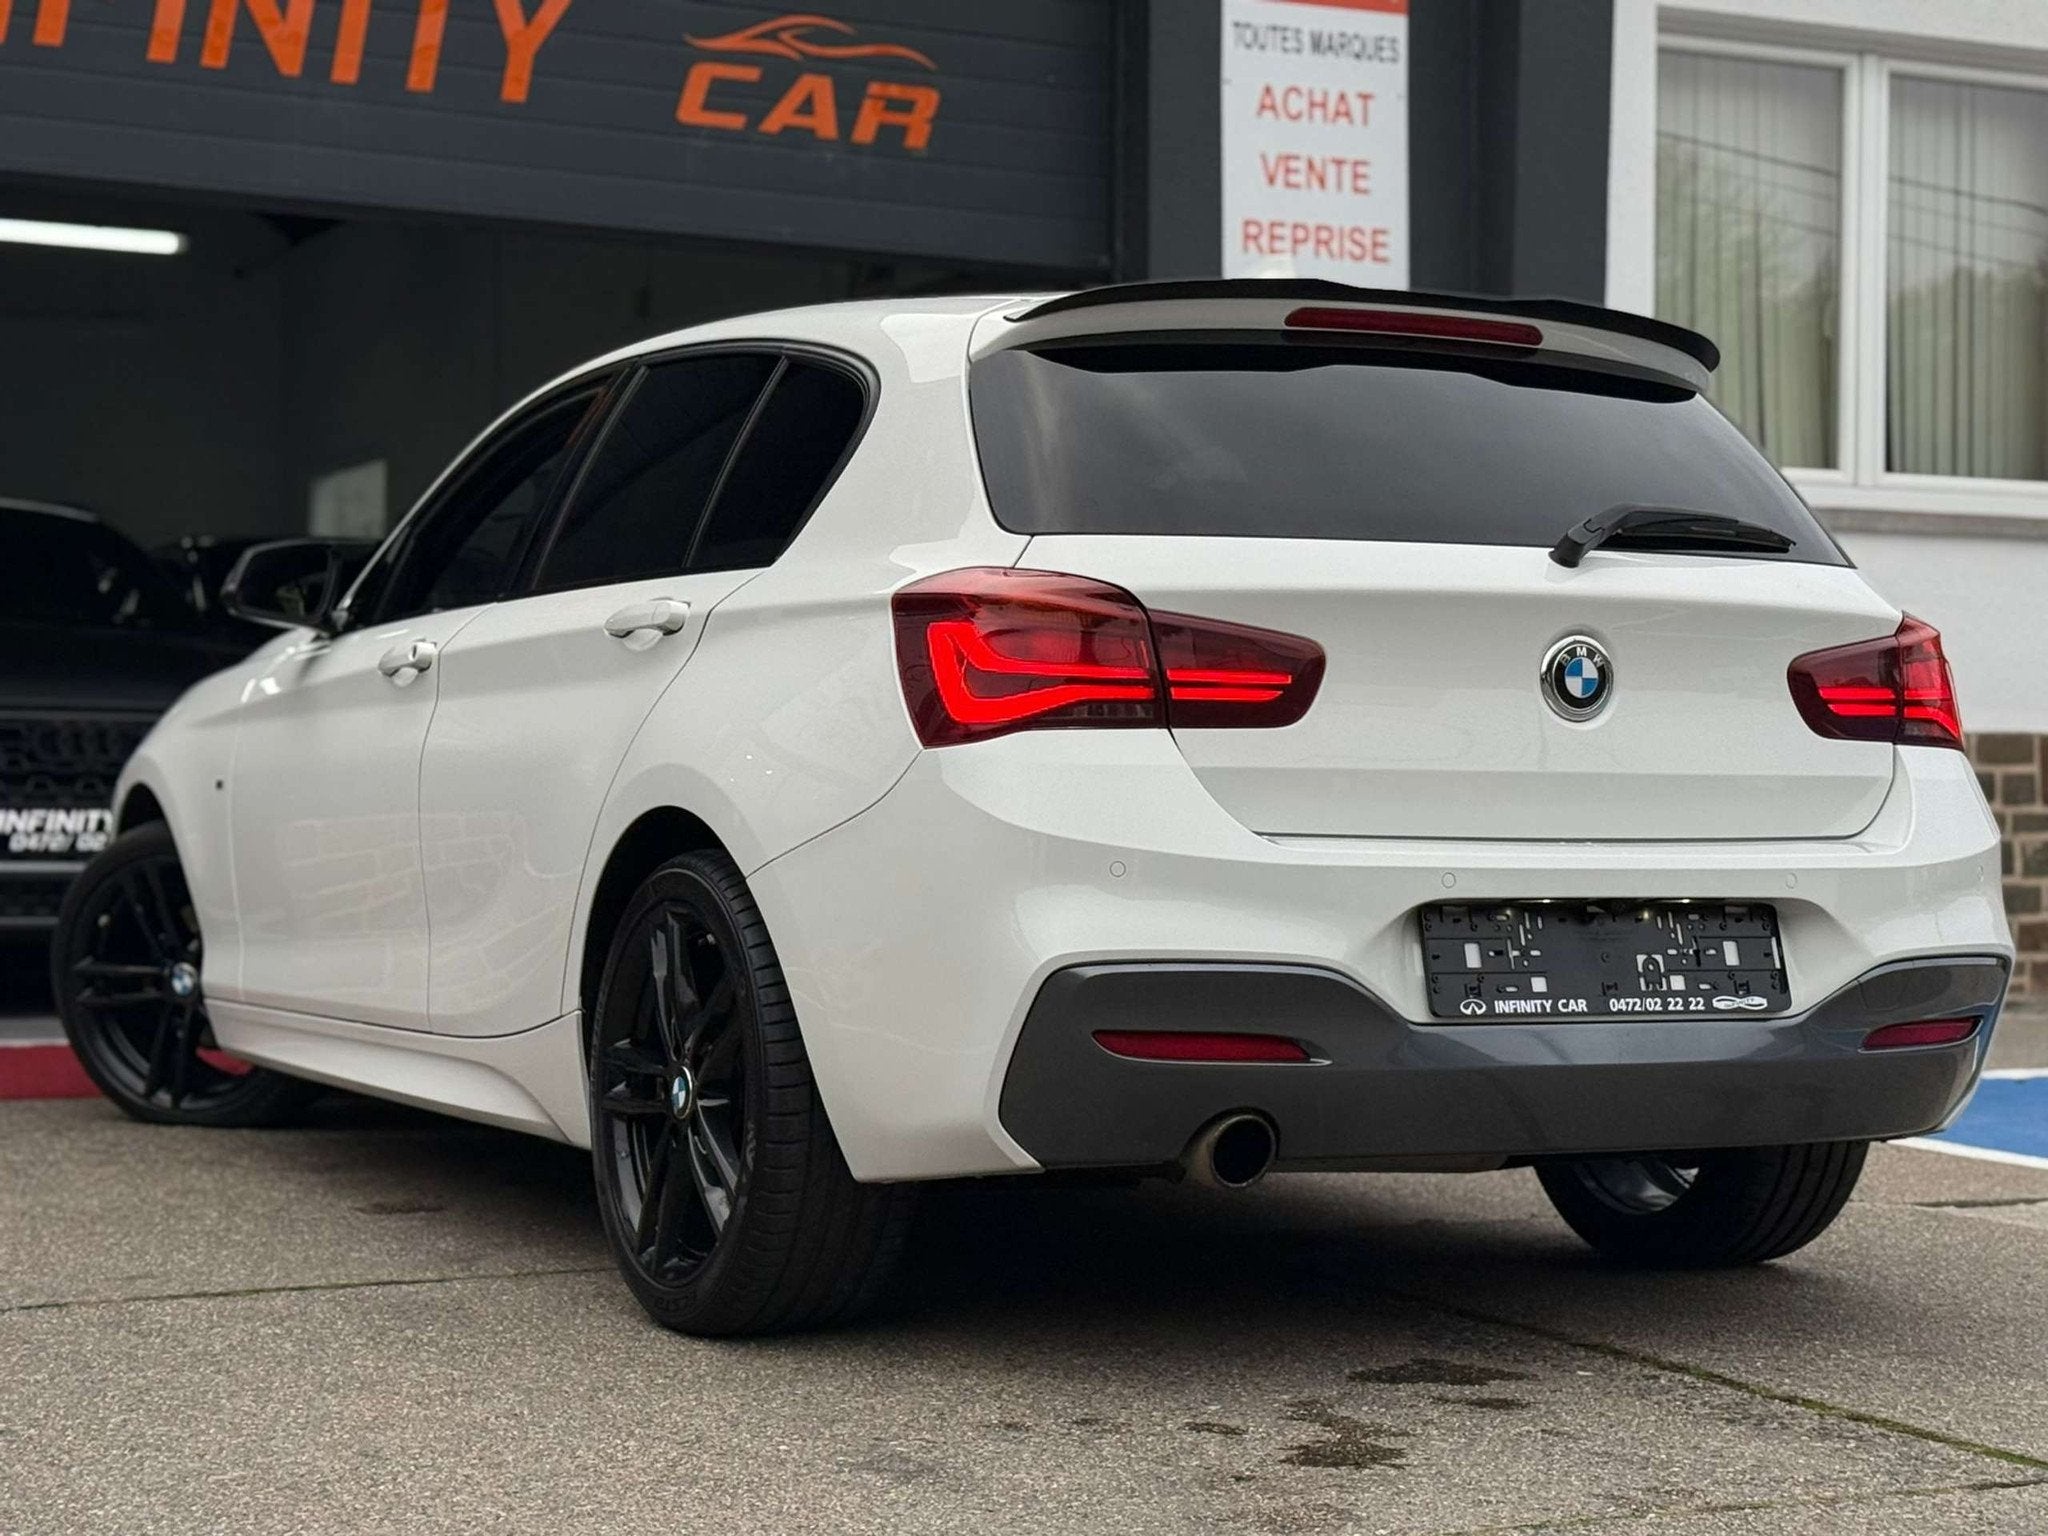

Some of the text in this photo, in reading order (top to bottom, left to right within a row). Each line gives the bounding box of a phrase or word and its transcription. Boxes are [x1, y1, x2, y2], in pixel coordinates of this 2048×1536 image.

[1232, 20, 1400, 64] TOUTES MARQUES
[675, 61, 941, 150] CAR
[1257, 82, 1376, 128] ACHAT
[1259, 151, 1371, 196] VENTE
[1241, 217, 1392, 265] REPRISE
[1560, 645, 1606, 668] BMW
[1494, 999, 1552, 1014] INFINITY
[1557, 999, 1588, 1013] CAR
[1609, 997, 1663, 1013] 0472/02
[1667, 997, 1684, 1011] 22
[1688, 997, 1706, 1011] 22
